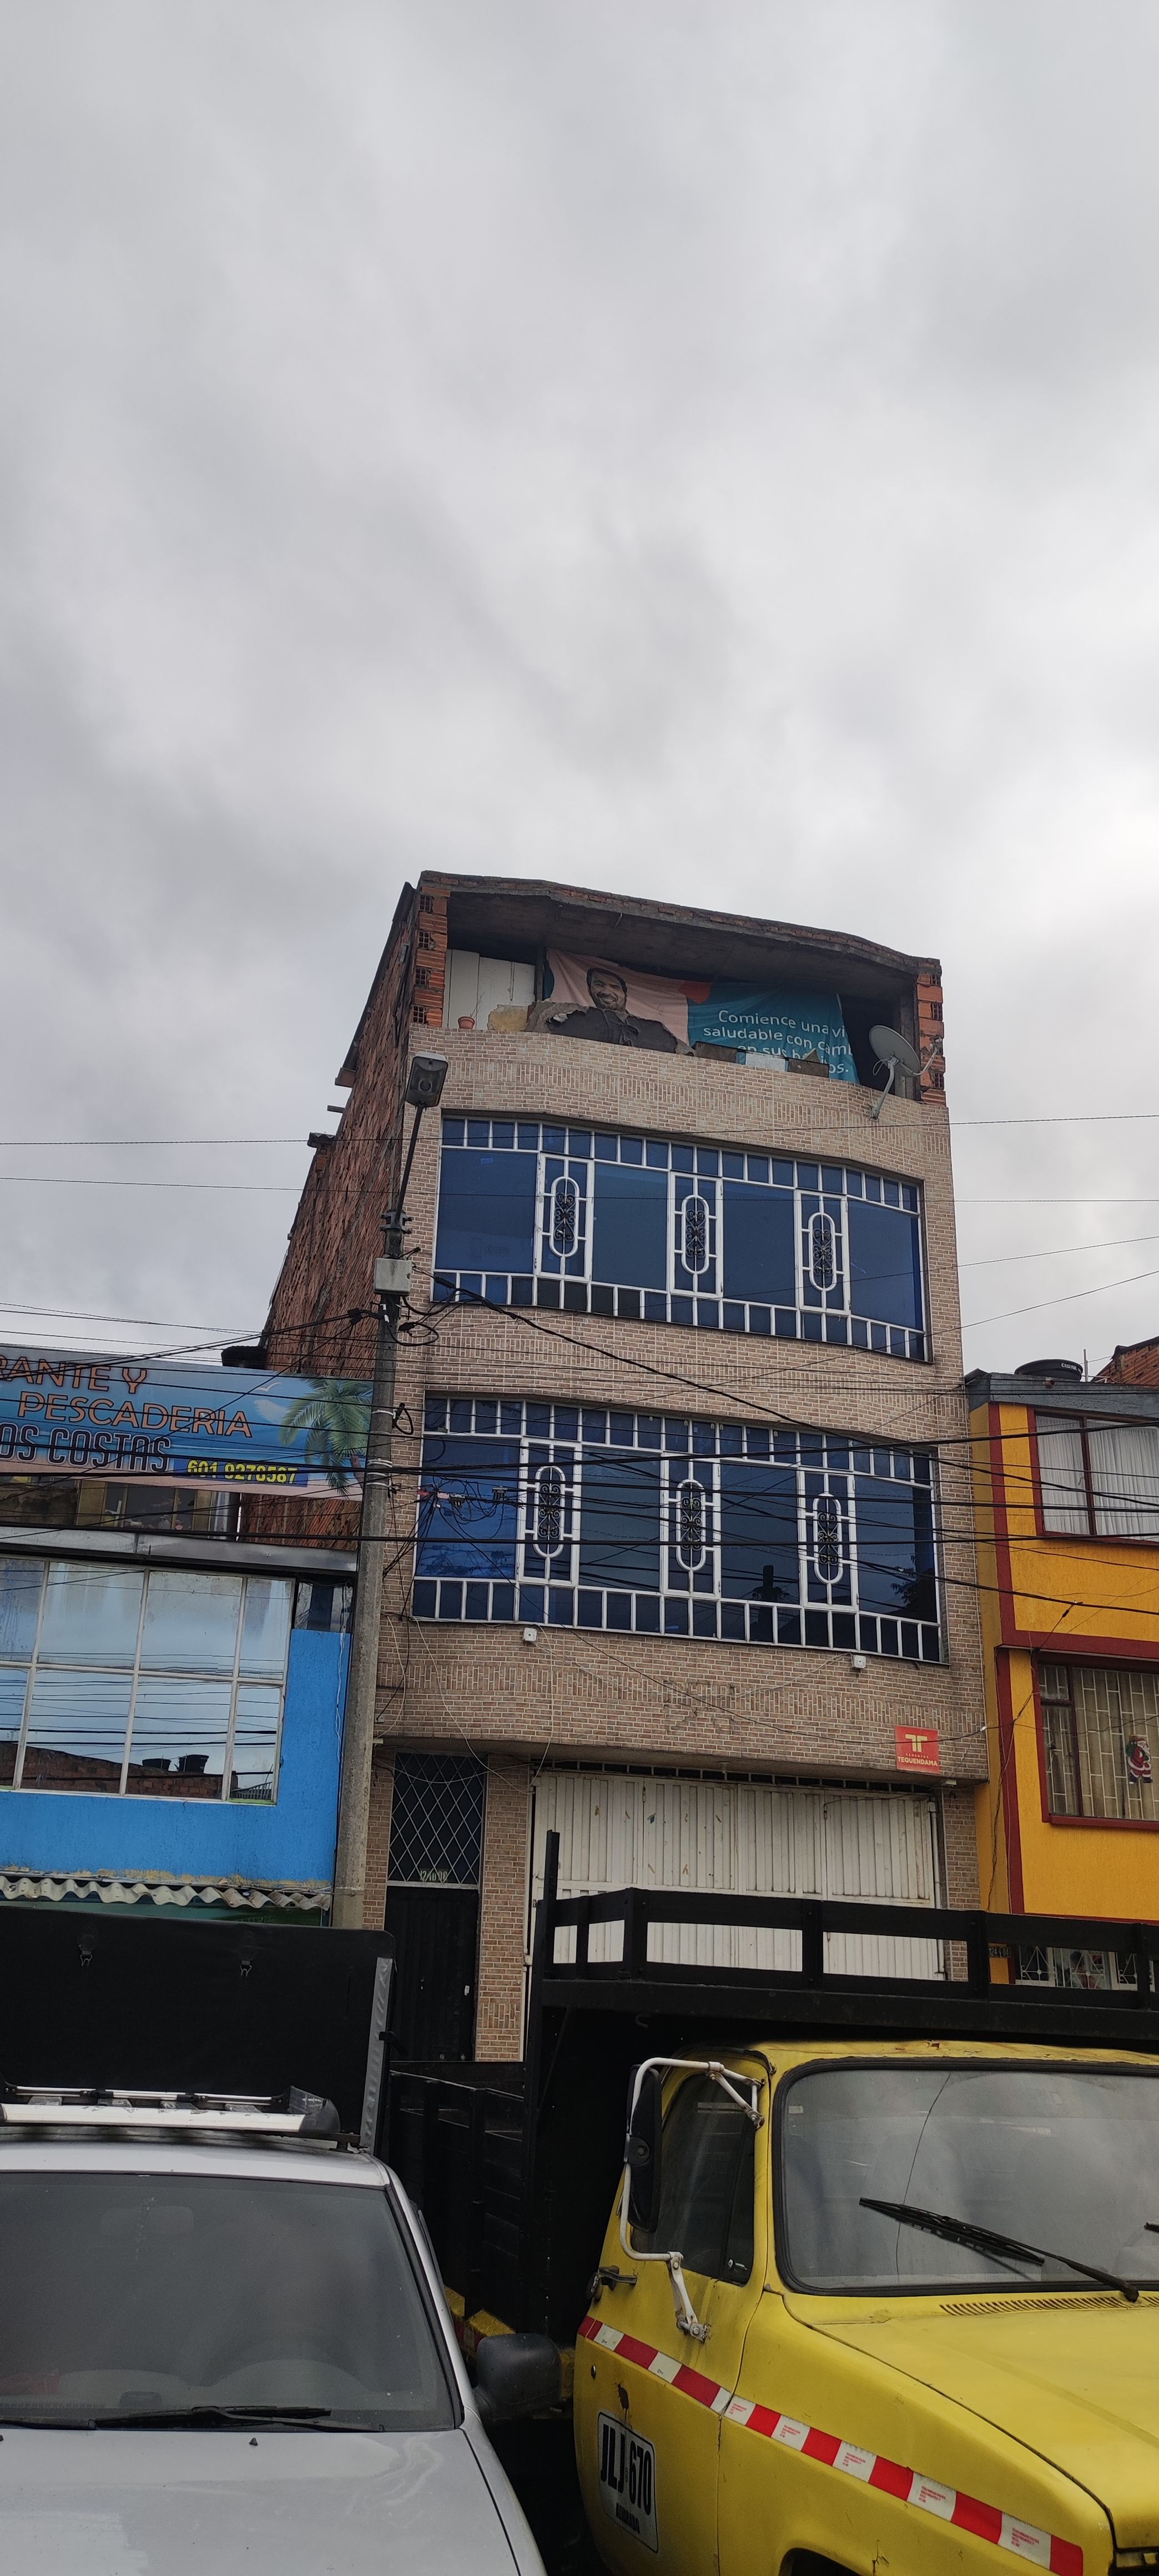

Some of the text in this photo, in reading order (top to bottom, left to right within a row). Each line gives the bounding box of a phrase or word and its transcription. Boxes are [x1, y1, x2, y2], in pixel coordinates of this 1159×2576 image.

[718, 1010, 796, 1029] Comience
[801, 1021, 829, 1035] una
[703, 1027, 783, 1041] saludable
[787, 1034, 812, 1049] con
[122, 1367, 147, 1394] Y
[17, 1390, 253, 1438] PESCADERIA
[48, 1427, 171, 1472] COSTAS
[187, 1459, 218, 1478] 601
[897, 1756, 938, 1767] TEQUENDAMA
